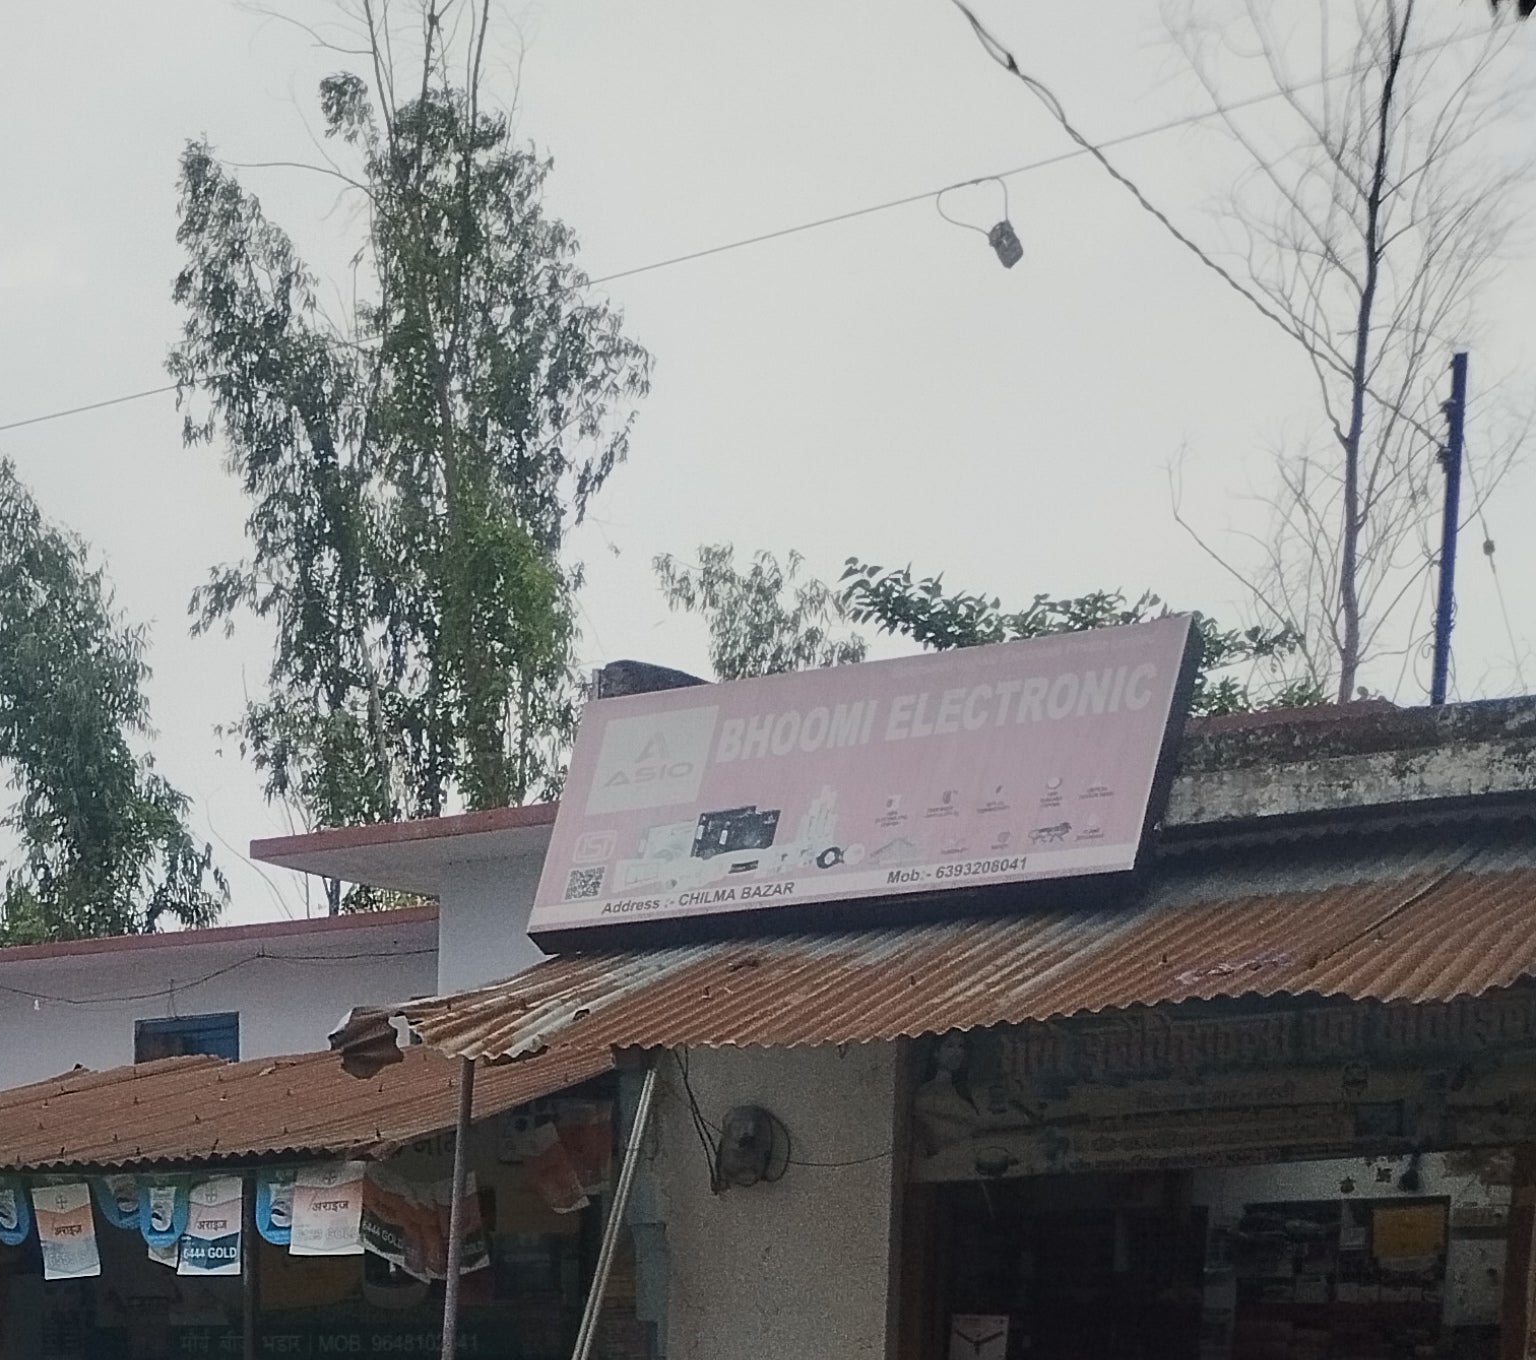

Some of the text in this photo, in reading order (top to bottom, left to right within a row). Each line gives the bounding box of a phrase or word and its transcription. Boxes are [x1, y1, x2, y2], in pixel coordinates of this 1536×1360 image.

[716, 661, 1158, 764] BHOOMI ELECTRONIC
[600, 760, 695, 790] ASIO
[935, 857, 1028, 880] 6393208041
[601, 899, 661, 915] Address
[678, 889, 736, 907] CHILMA
[740, 882, 795, 900] BAZAR
[207, 1247, 237, 1258] GOLD
